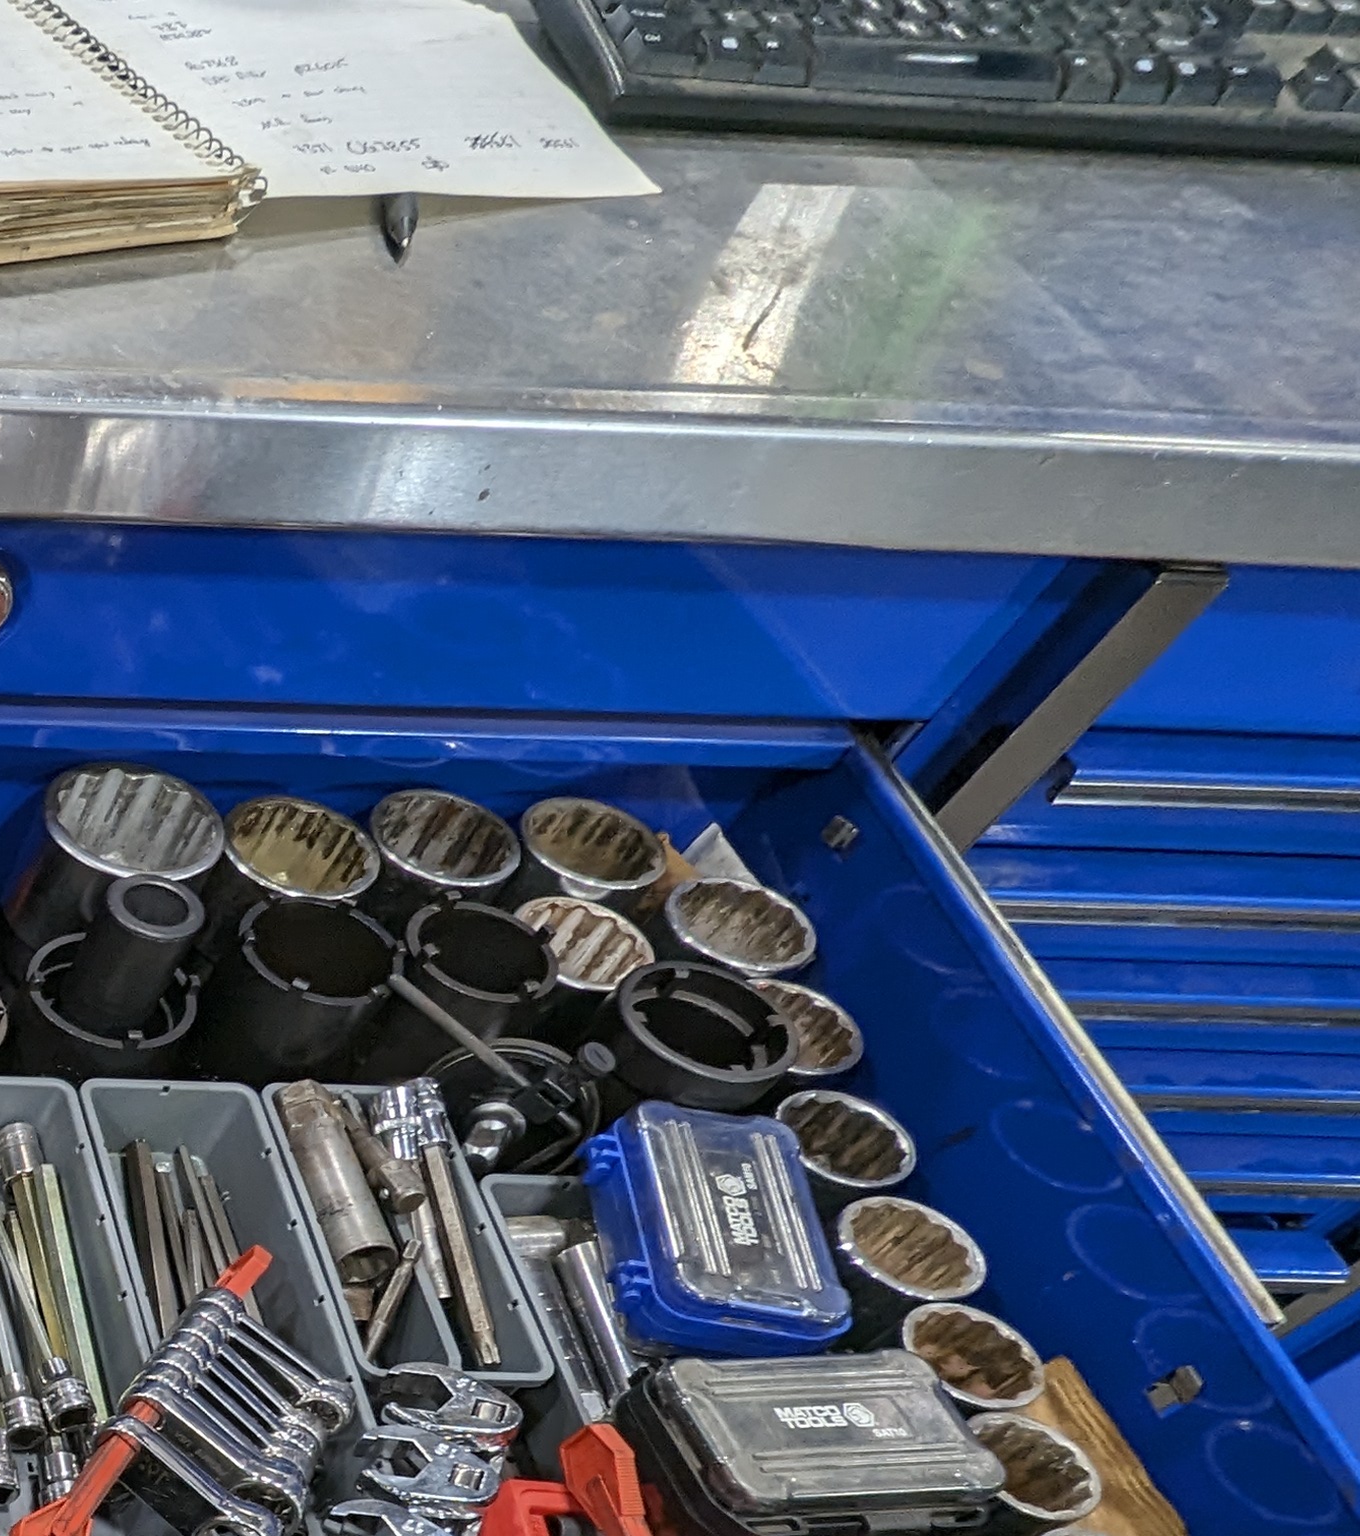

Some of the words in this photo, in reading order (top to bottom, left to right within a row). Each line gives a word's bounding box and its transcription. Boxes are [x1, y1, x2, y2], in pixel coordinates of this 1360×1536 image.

[722, 1195, 752, 1246] MATCO
[735, 1198, 760, 1245] TOOLS
[773, 1405, 841, 1418] MATCO
[780, 1415, 848, 1429] TOOLS
